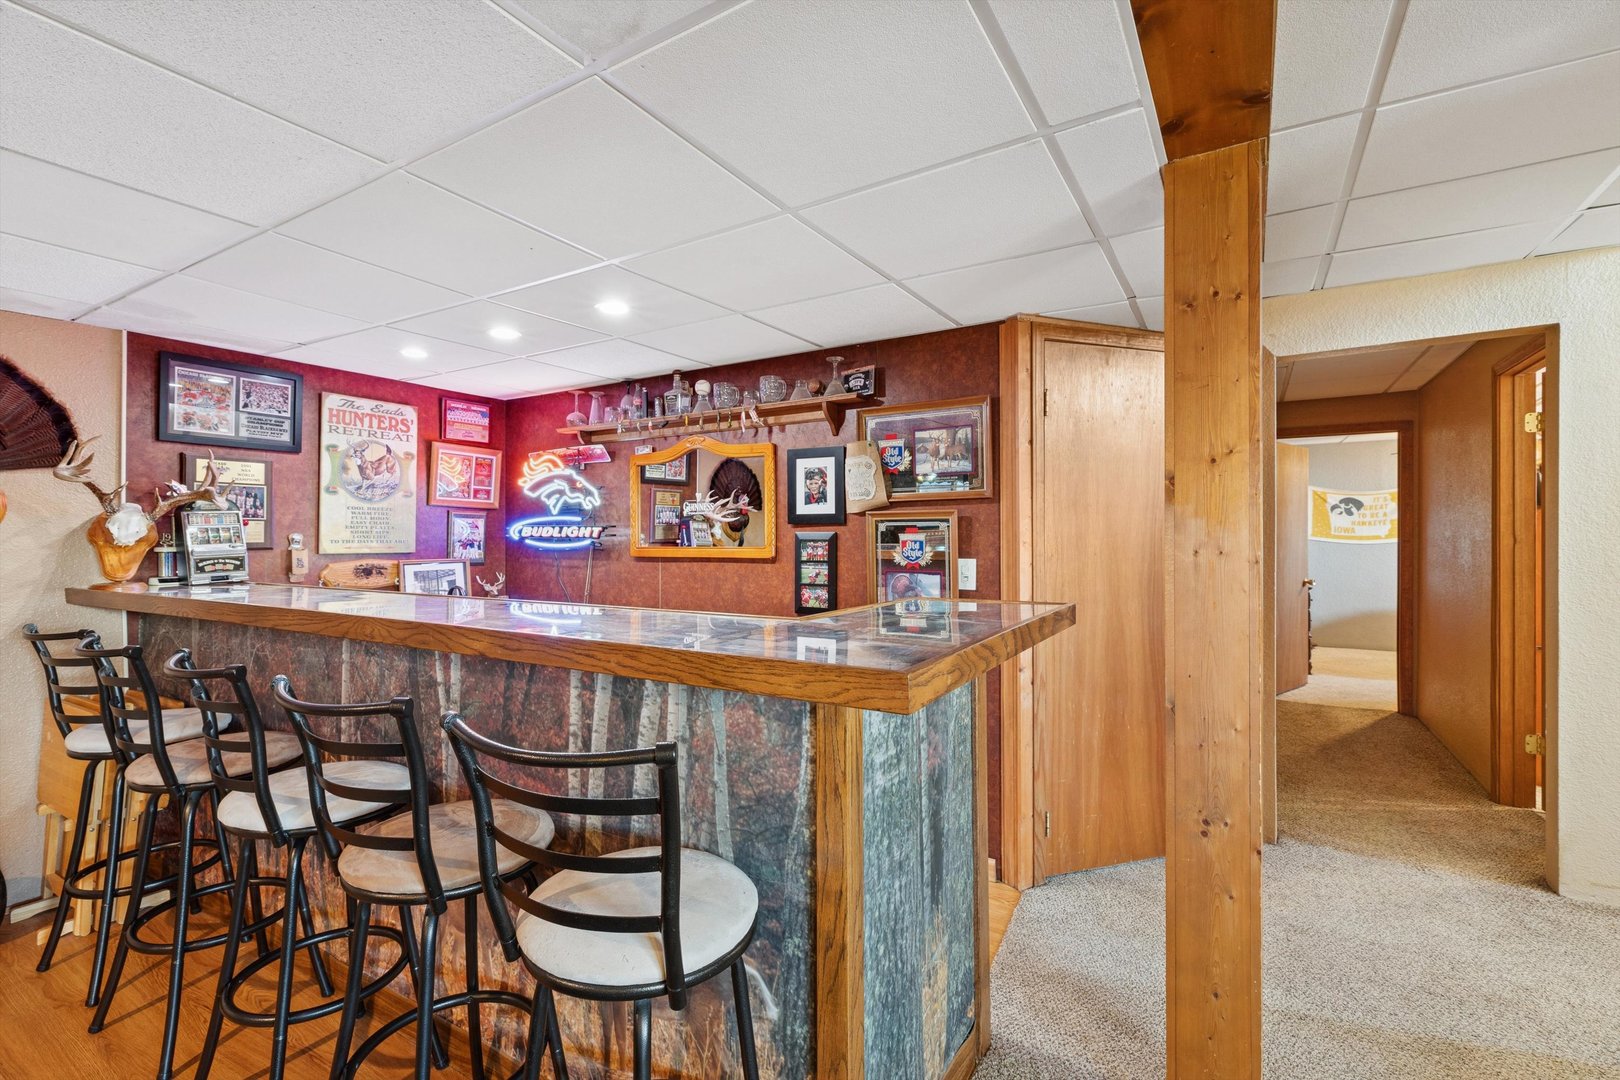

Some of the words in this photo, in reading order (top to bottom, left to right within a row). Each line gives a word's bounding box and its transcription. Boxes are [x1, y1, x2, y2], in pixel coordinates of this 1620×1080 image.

[337, 398, 365, 411] The
[370, 404, 406, 417] Eads
[327, 407, 413, 433] HUNTERS'
[328, 425, 414, 442] RETREAT
[885, 446, 899, 456] Old
[882, 454, 902, 466] Style
[1363, 503, 1388, 511] GREAT
[1333, 526, 1356, 534] IOWA
[906, 540, 920, 550] Old
[902, 547, 923, 560] Style
